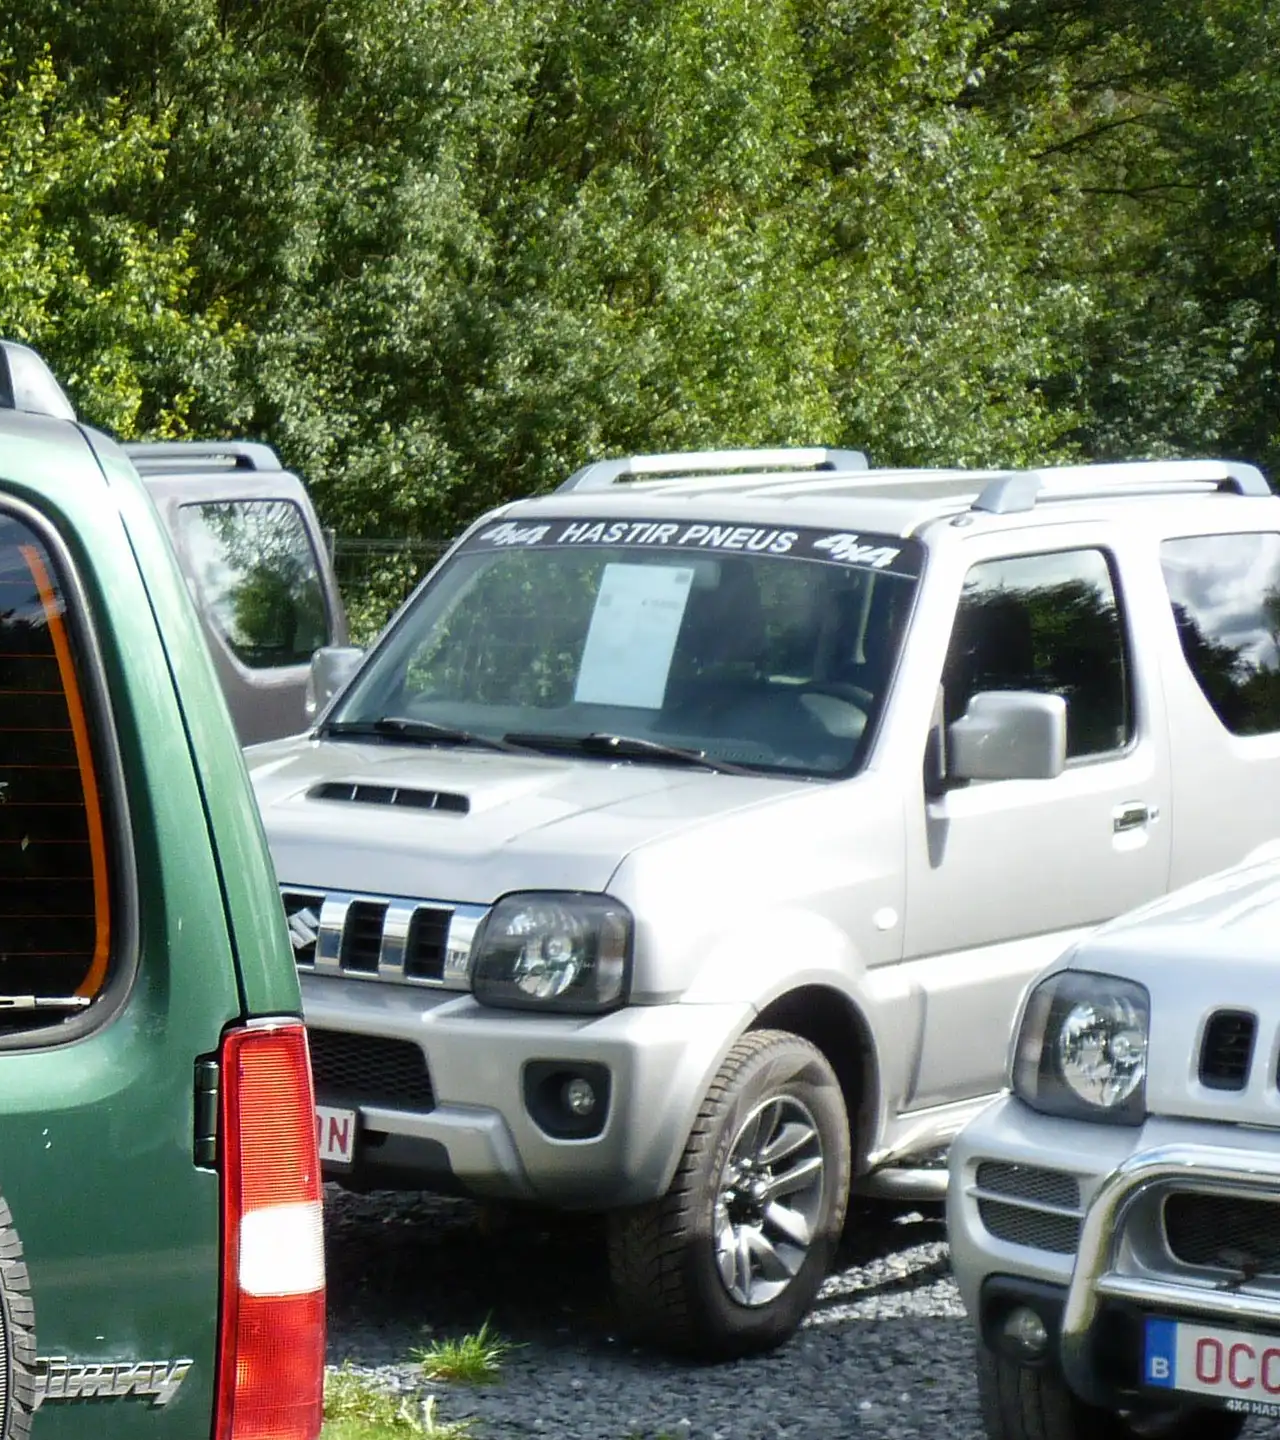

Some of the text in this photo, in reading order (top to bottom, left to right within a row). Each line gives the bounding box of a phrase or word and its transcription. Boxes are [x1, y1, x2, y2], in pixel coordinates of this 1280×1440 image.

[557, 523, 675, 545] HASTIR
[680, 527, 799, 553] PNEUS
[1151, 1356, 1169, 1378] B
